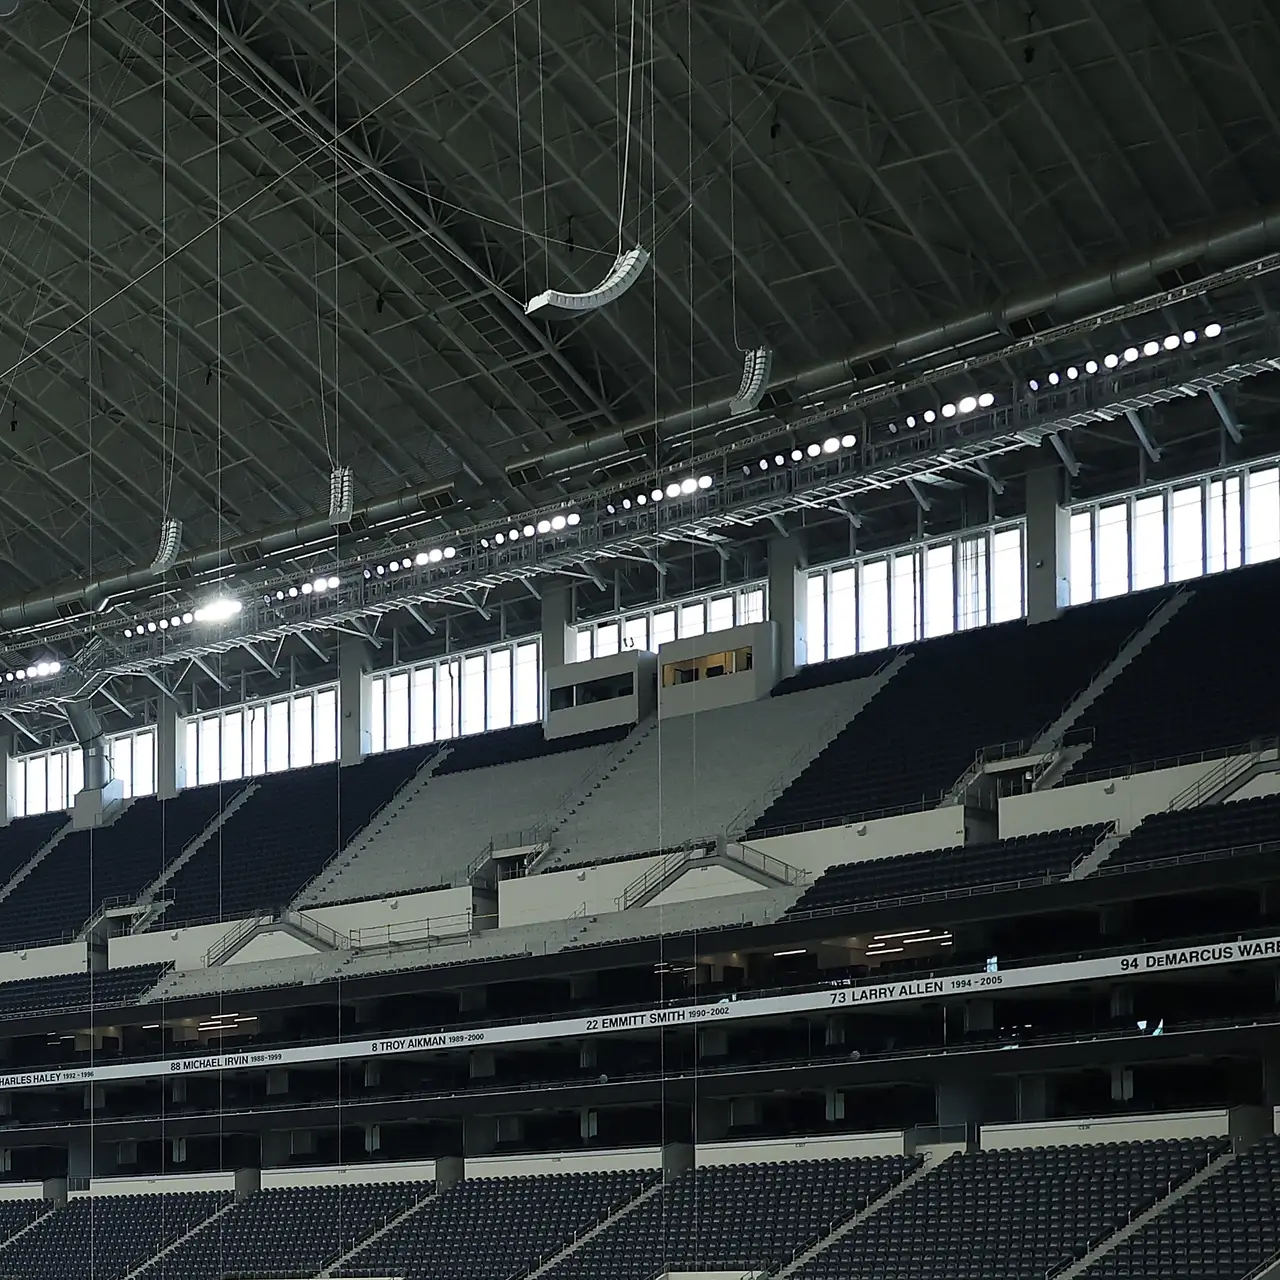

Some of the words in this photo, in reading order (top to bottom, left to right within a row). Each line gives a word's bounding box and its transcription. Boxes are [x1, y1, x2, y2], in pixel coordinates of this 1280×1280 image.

[1120, 957, 1139, 971] 94
[830, 992, 846, 1005] 73
[851, 986, 897, 1002] LARRY
[898, 981, 944, 997] ALLEN
[950, 979, 972, 989] 1994
[980, 976, 1003, 986] 2005
[586, 1020, 599, 1031] 22
[602, 1014, 647, 1029] EMMITT
[649, 1010, 686, 1024] SMITH
[371, 1042, 378, 1052] 8
[379, 1039, 406, 1051] TROY
[407, 1035, 446, 1049] AIKMAN
[170, 1061, 181, 1071] 88
[183, 1058, 223, 1070] MICHAEL
[224, 1055, 249, 1066] IRVIN
[33, 1073, 62, 1084] HALEY
